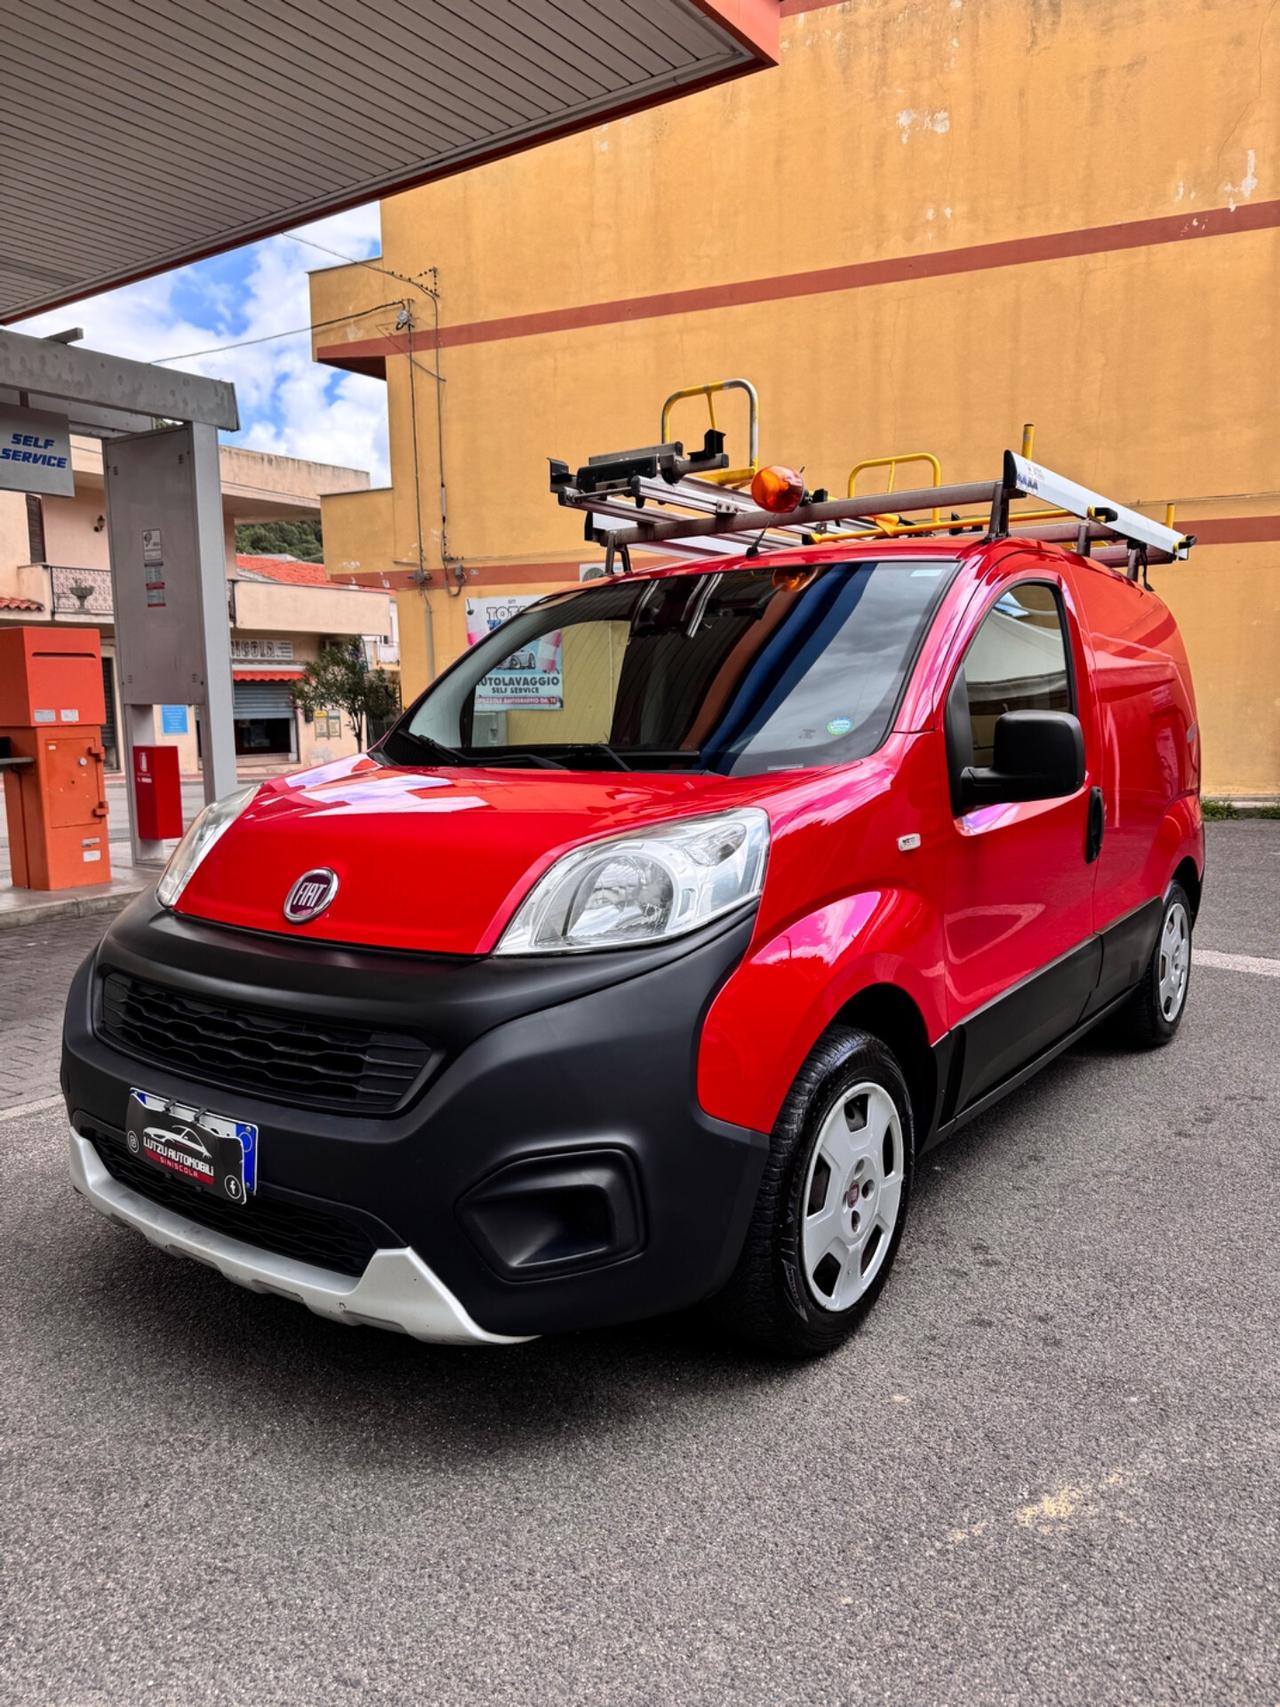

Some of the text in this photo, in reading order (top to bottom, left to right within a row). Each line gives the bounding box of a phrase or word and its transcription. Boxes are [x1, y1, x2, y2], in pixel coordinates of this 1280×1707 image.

[11, 432, 55, 450] SELF
[0, 447, 68, 469] SERVICE
[492, 686, 540, 694] SELF SERVICE
[292, 881, 328, 908] FIAT
[143, 1136, 167, 1156] LUTZU
[160, 1156, 199, 1178] SINISCOLA
